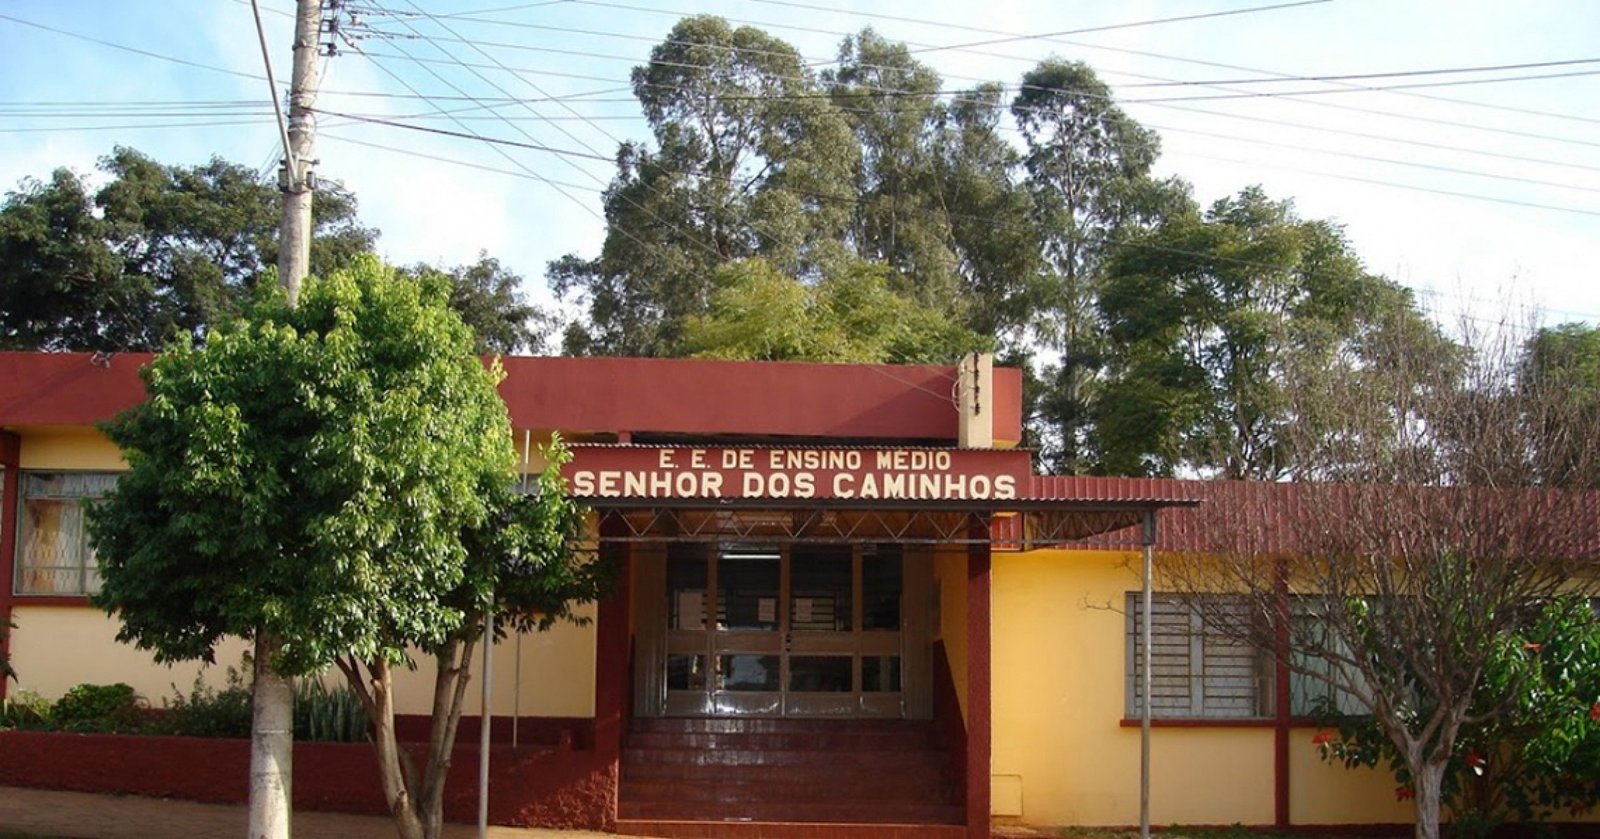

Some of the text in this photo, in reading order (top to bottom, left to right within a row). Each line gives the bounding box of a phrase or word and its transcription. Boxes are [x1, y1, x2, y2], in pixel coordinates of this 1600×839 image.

[659, 449, 951, 471] E. E. DE ENSINO MÉDIO
[573, 470, 1016, 500] SENHOR DOS CAMINHOS
